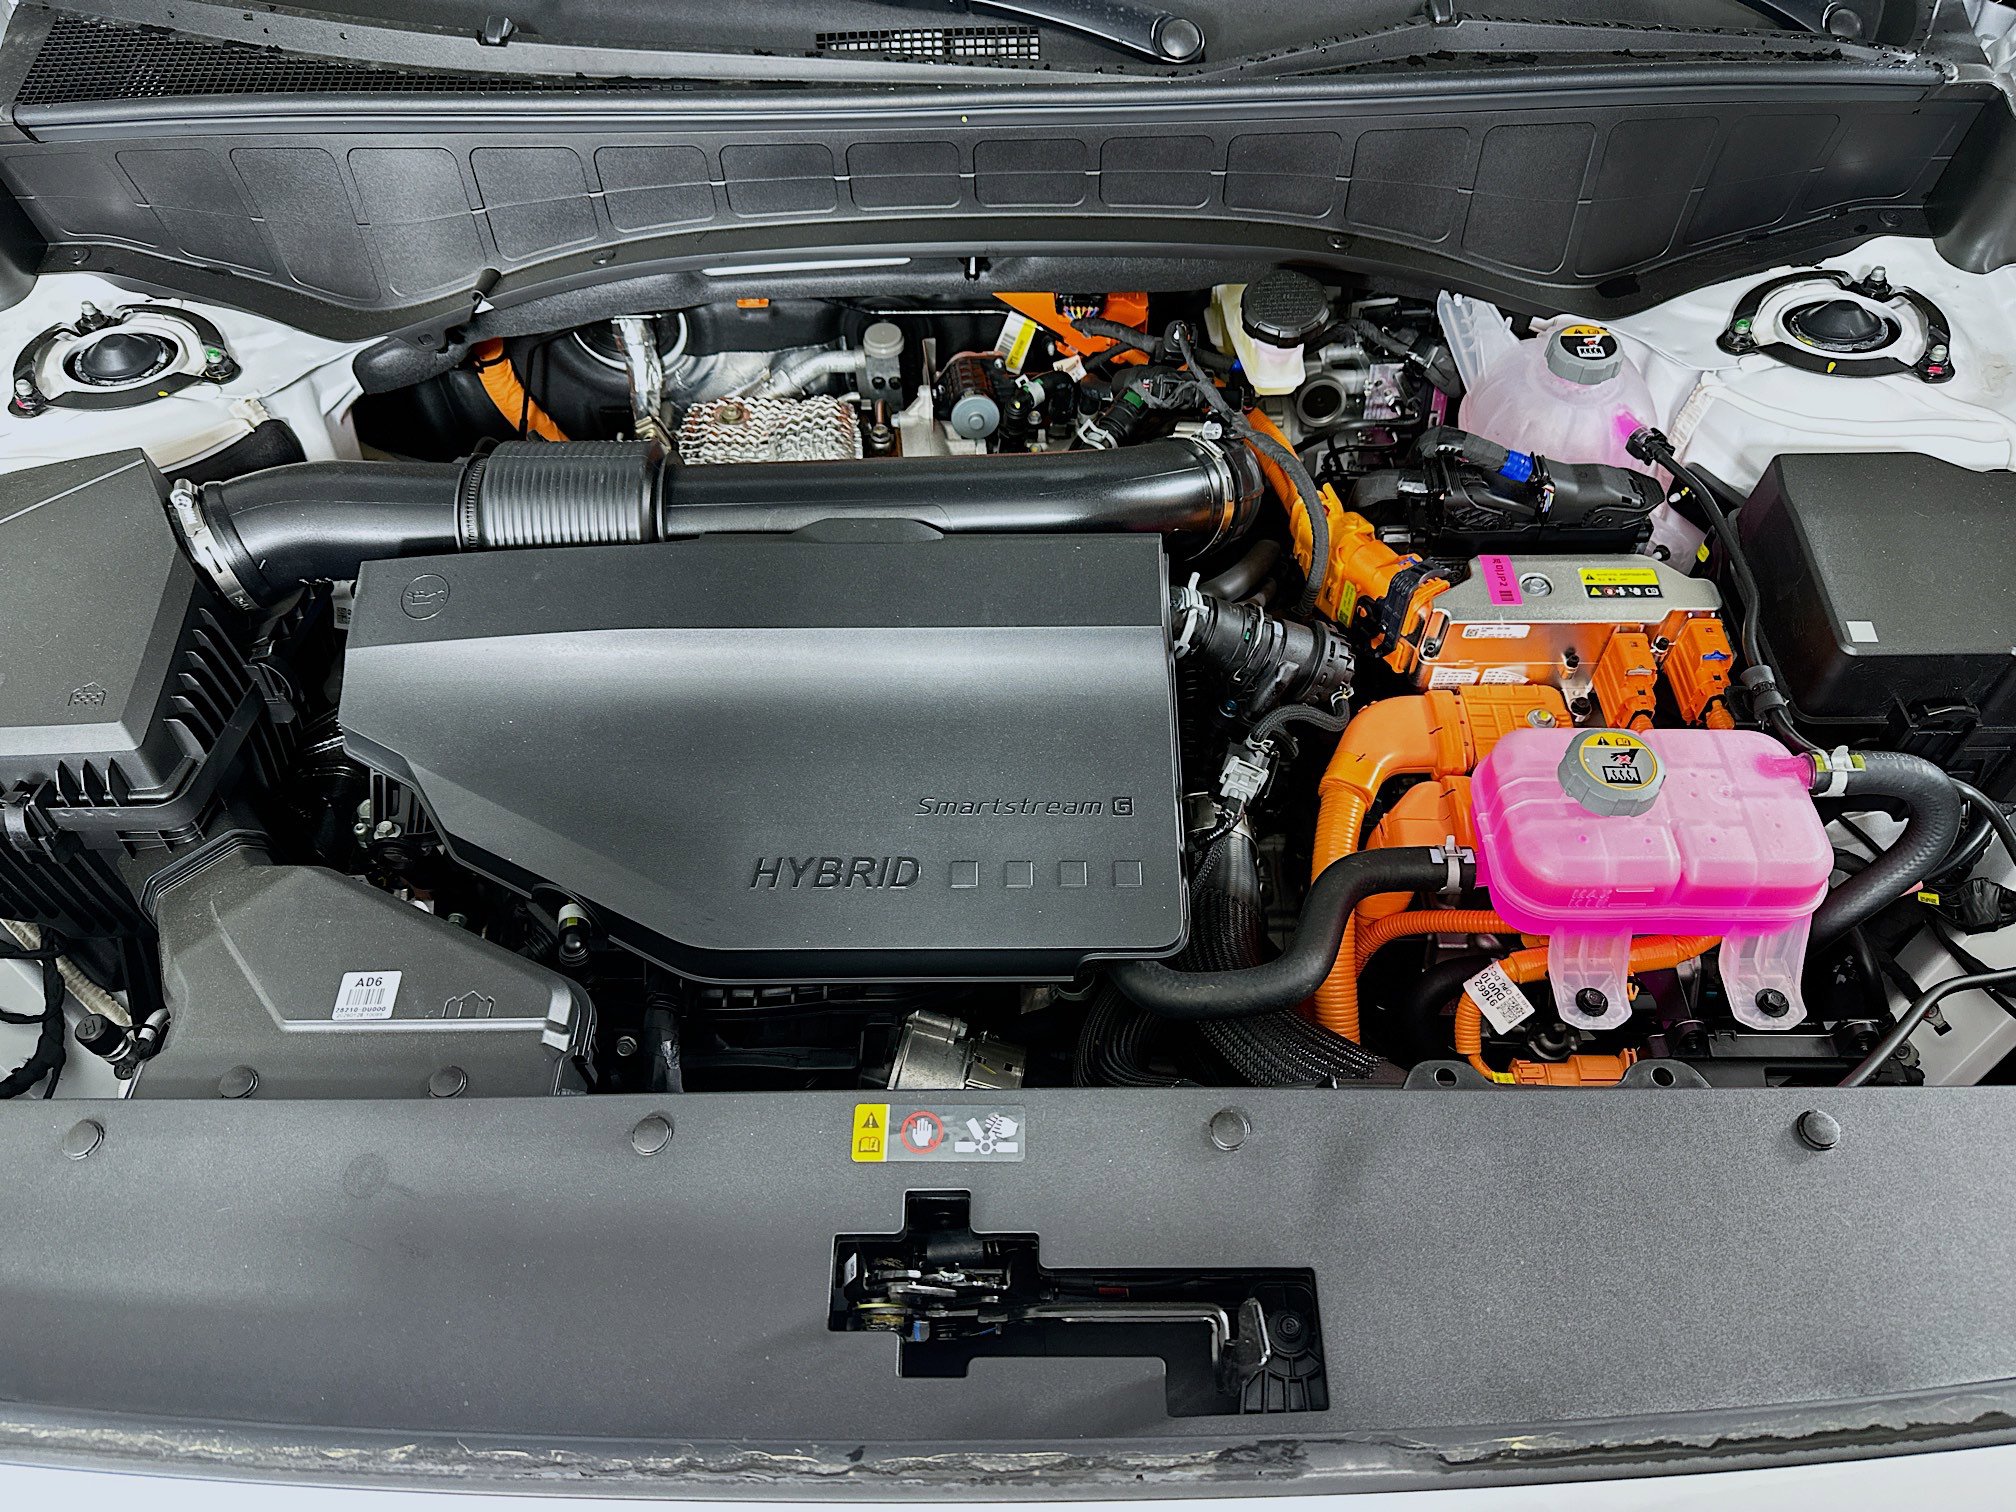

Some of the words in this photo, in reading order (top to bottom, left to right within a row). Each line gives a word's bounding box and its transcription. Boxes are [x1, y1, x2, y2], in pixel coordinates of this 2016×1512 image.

[915, 796, 1104, 817] Smartstream
[1114, 797, 1134, 816] G
[749, 856, 922, 890] HYBRID
[355, 976, 383, 988] AD6
[1474, 979, 1498, 1007] 91662
[1480, 972, 1506, 1001] DU010
